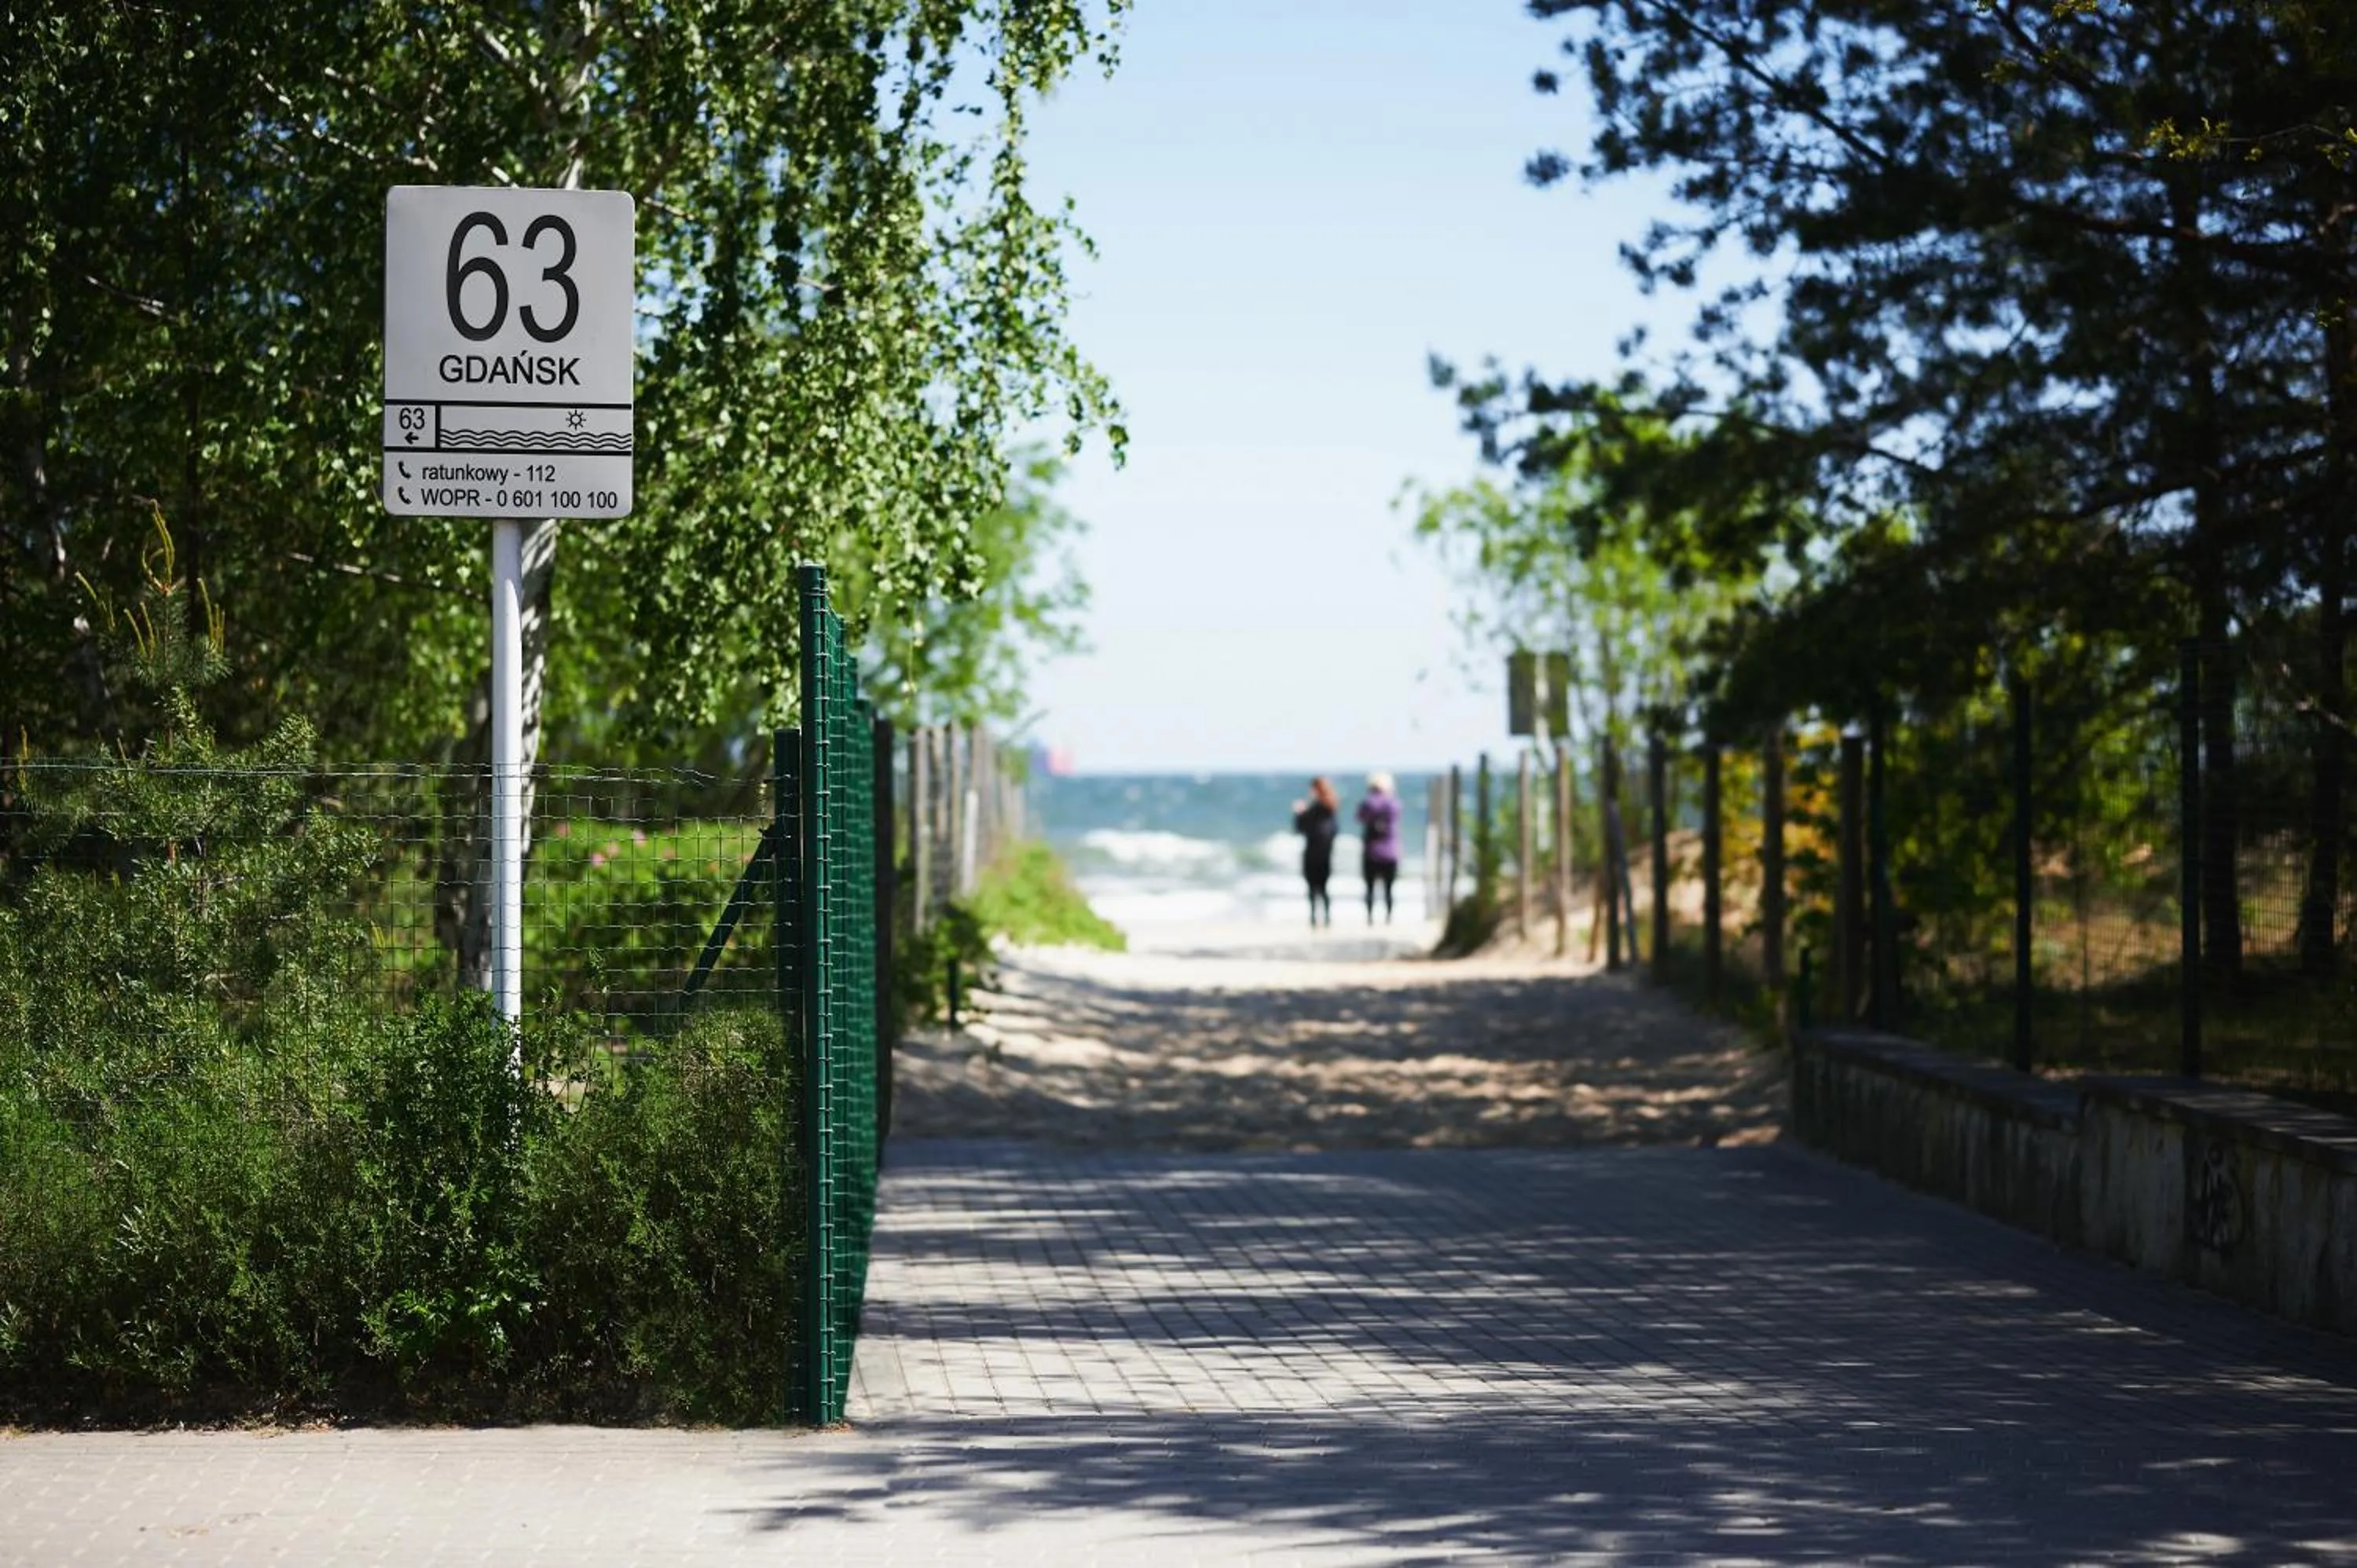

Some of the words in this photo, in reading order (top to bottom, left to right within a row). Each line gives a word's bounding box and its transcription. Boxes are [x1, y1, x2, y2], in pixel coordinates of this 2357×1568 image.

[446, 211, 580, 343] 63
[438, 350, 581, 385] GDAŃSK
[398, 408, 425, 430] 63
[422, 463, 509, 485] ratunkowy
[526, 465, 555, 482] 112
[421, 488, 481, 507] WOPR
[497, 489, 508, 507] 0
[512, 490, 542, 508] 601
[551, 490, 581, 508] 100
[587, 491, 618, 509] 100
